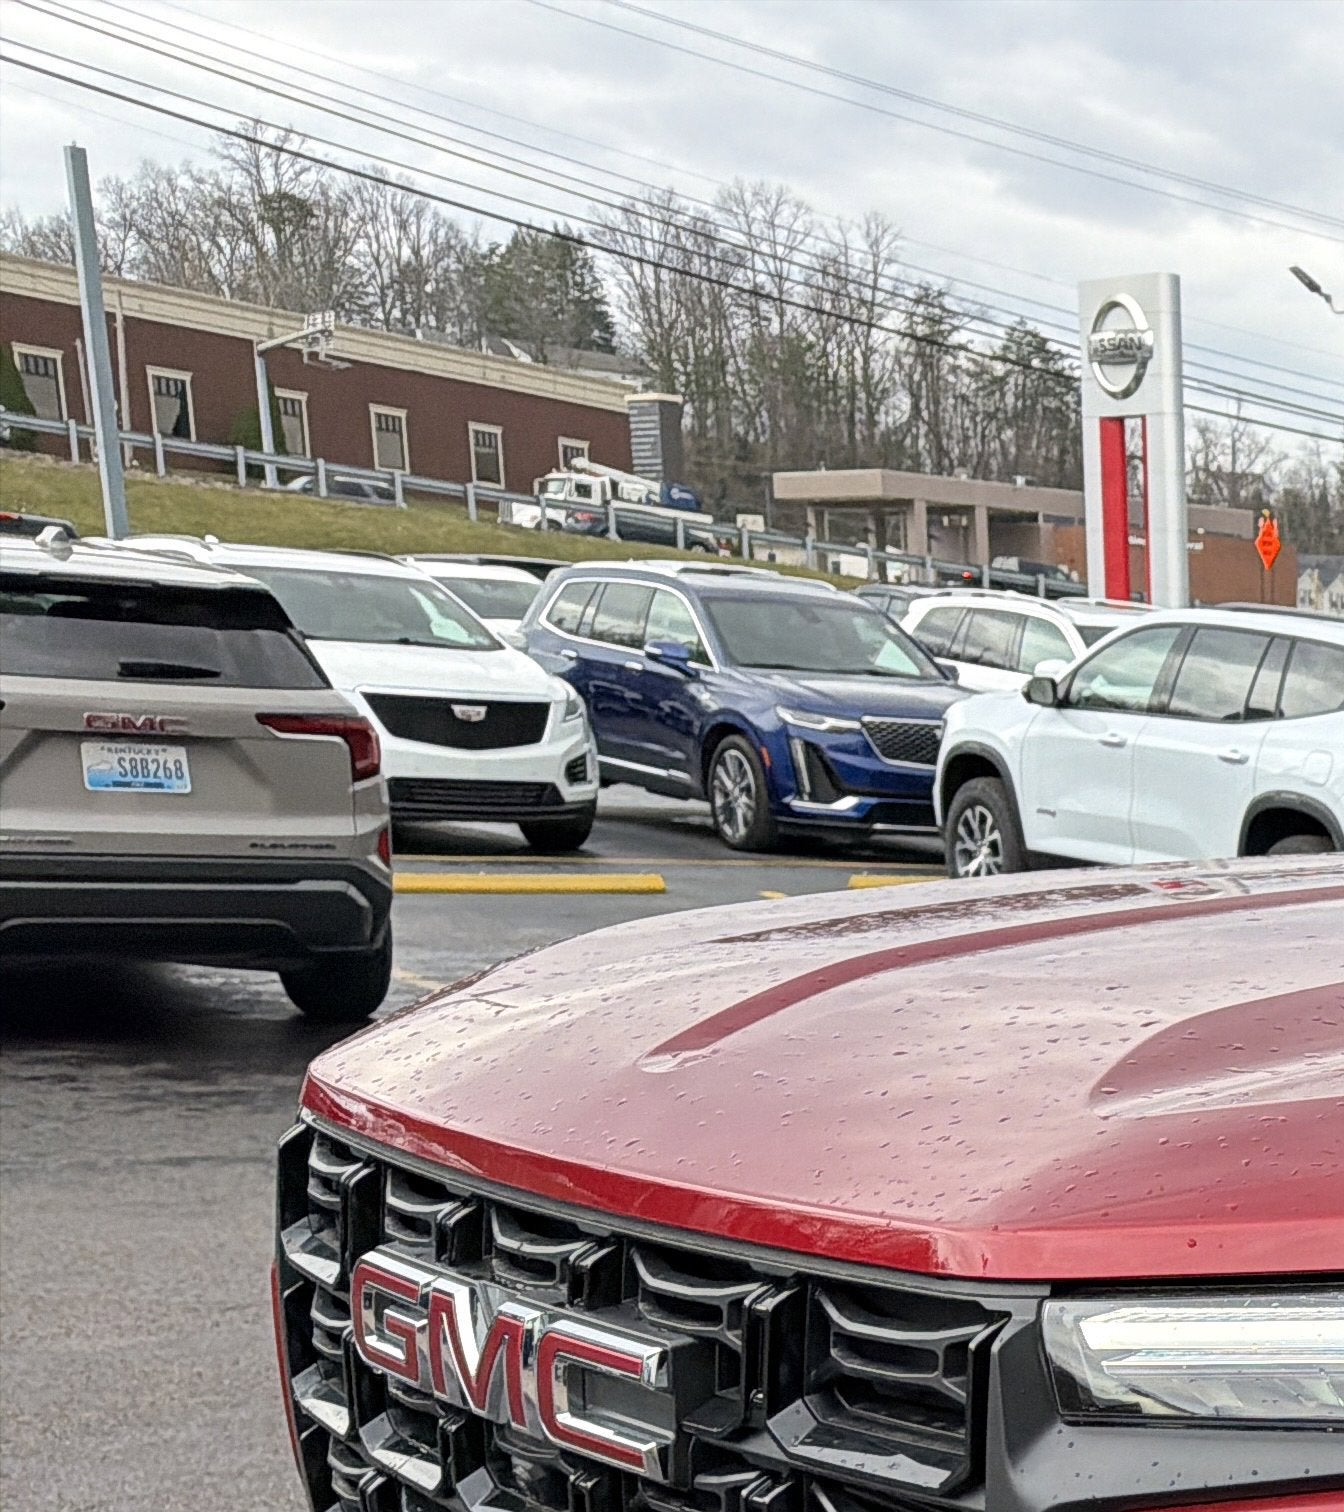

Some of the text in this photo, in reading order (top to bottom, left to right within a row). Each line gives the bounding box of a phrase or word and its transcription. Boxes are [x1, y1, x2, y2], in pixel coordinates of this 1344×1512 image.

[1089, 335, 1143, 354] SSAN
[83, 711, 189, 733] GMC
[117, 756, 185, 780] S8B268
[352, 1252, 668, 1480] GMC
